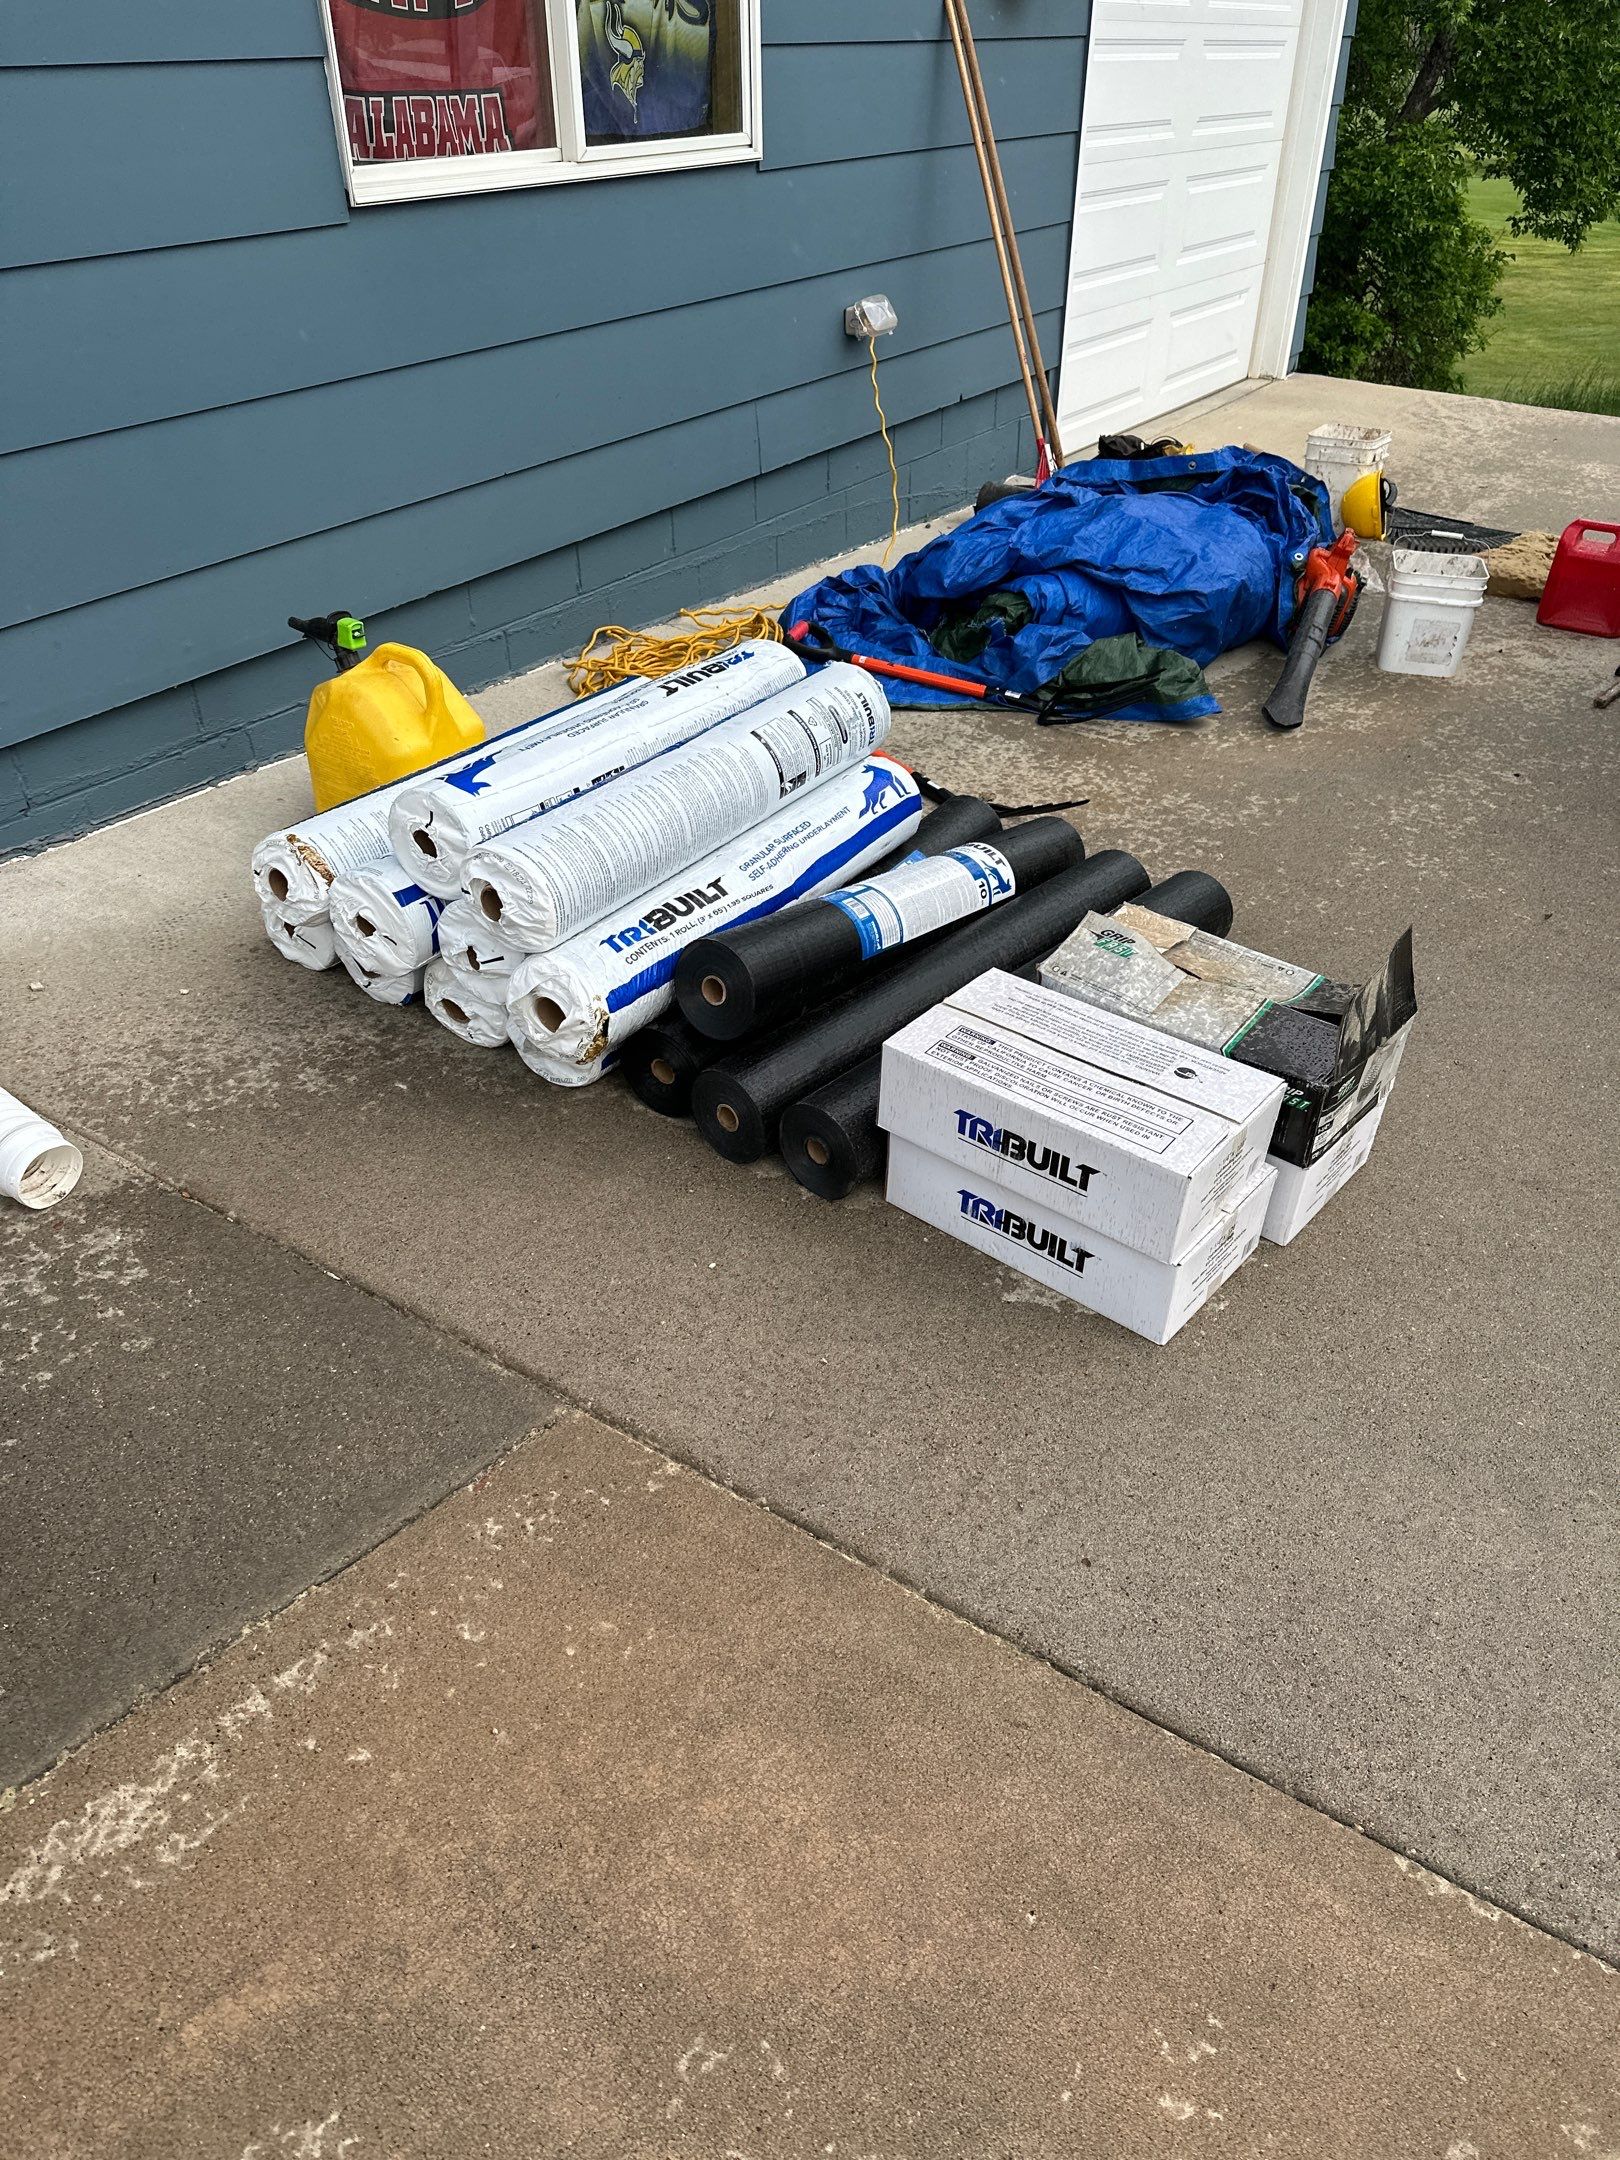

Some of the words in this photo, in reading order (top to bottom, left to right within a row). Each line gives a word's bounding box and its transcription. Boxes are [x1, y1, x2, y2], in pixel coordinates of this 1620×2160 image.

[344, 93, 511, 162] ALABAMA
[738, 842, 776, 872] GRANULAR
[773, 820, 812, 847] SURFACED
[748, 840, 800, 882] SELF-ADHERNG
[799, 805, 851, 844] UNDERLAYMENT
[599, 876, 729, 954] TRIBUILT
[742, 883, 775, 902] SQUARES
[977, 880, 988, 900] 10
[1099, 929, 1137, 945] GRIP
[930, 1050, 965, 1068] EXTERIOR
[951, 1035, 974, 1048] OTHER
[973, 1043, 1028, 1070] REPRODUCTIVE
[956, 1031, 977, 1043] STATE
[987, 1044, 1029, 1065] CALIFORNIA
[1028, 1063, 1038, 1071] TO
[1037, 1067, 1062, 1081] CAUSE
[1095, 1091, 1107, 1099] OR
[1107, 1095, 1131, 1108] BIRTH
[1130, 1103, 1167, 1121] DEFECTS
[1166, 1118, 1179, 1127] OR
[998, 1044, 1016, 1055] THIS
[1015, 1050, 1046, 1067] PRODUCT
[1047, 1062, 1082, 1081] CONTAINS
[1089, 1082, 1126, 1099] CHEMICAL
[1126, 1095, 1157, 1110] KNOWN
[1157, 1108, 1168, 1116] TO
[1167, 1112, 1184, 1123] THE
[935, 1045, 950, 1056] NOT
[949, 1051, 971, 1063] RUST
[994, 1072, 1050, 1101] DISCOLORATION
[1049, 1096, 1068, 1108] WILL
[1068, 1104, 1095, 1118] OCCUR
[1095, 1114, 1120, 1127] WHEN
[1119, 1124, 1142, 1137] USED
[1141, 1133, 1151, 1141] IN
[977, 1059, 1021, 1081] GALVANIZED
[1019, 1077, 1041, 1089] NAILS
[1041, 1086, 1053, 1095] OR
[1052, 1091, 1085, 1108] SCREWS
[1084, 1105, 1100, 1114] ARE
[1101, 1110, 1123, 1122] RUST
[954, 1108, 1101, 1193] TRIBUILT
[957, 1189, 1096, 1274] TRIBUILT
